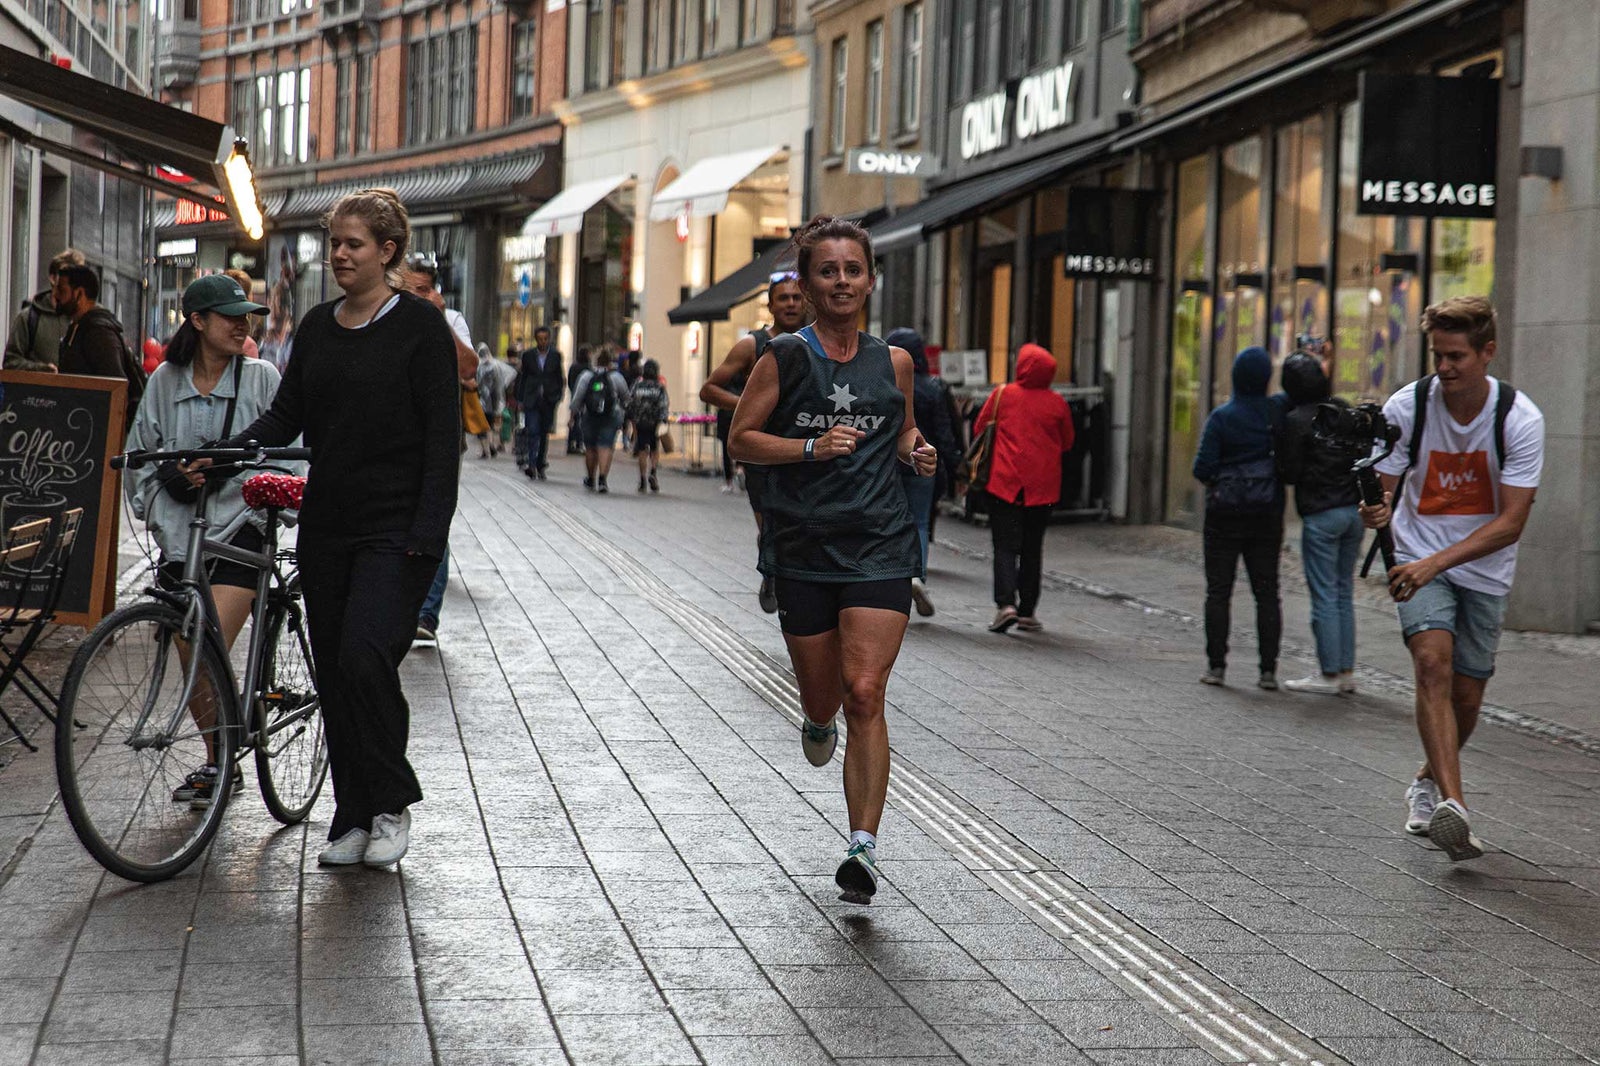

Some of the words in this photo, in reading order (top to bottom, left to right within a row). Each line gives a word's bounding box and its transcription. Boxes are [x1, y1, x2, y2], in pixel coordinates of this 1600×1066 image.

[1016, 61, 1073, 139] ONLY
[961, 88, 1006, 159] ONLY
[858, 152, 921, 174] ONLY
[1362, 180, 1496, 206] MESSAGE
[1066, 255, 1153, 274] MESSAGE
[795, 412, 886, 429] SAYSKY
